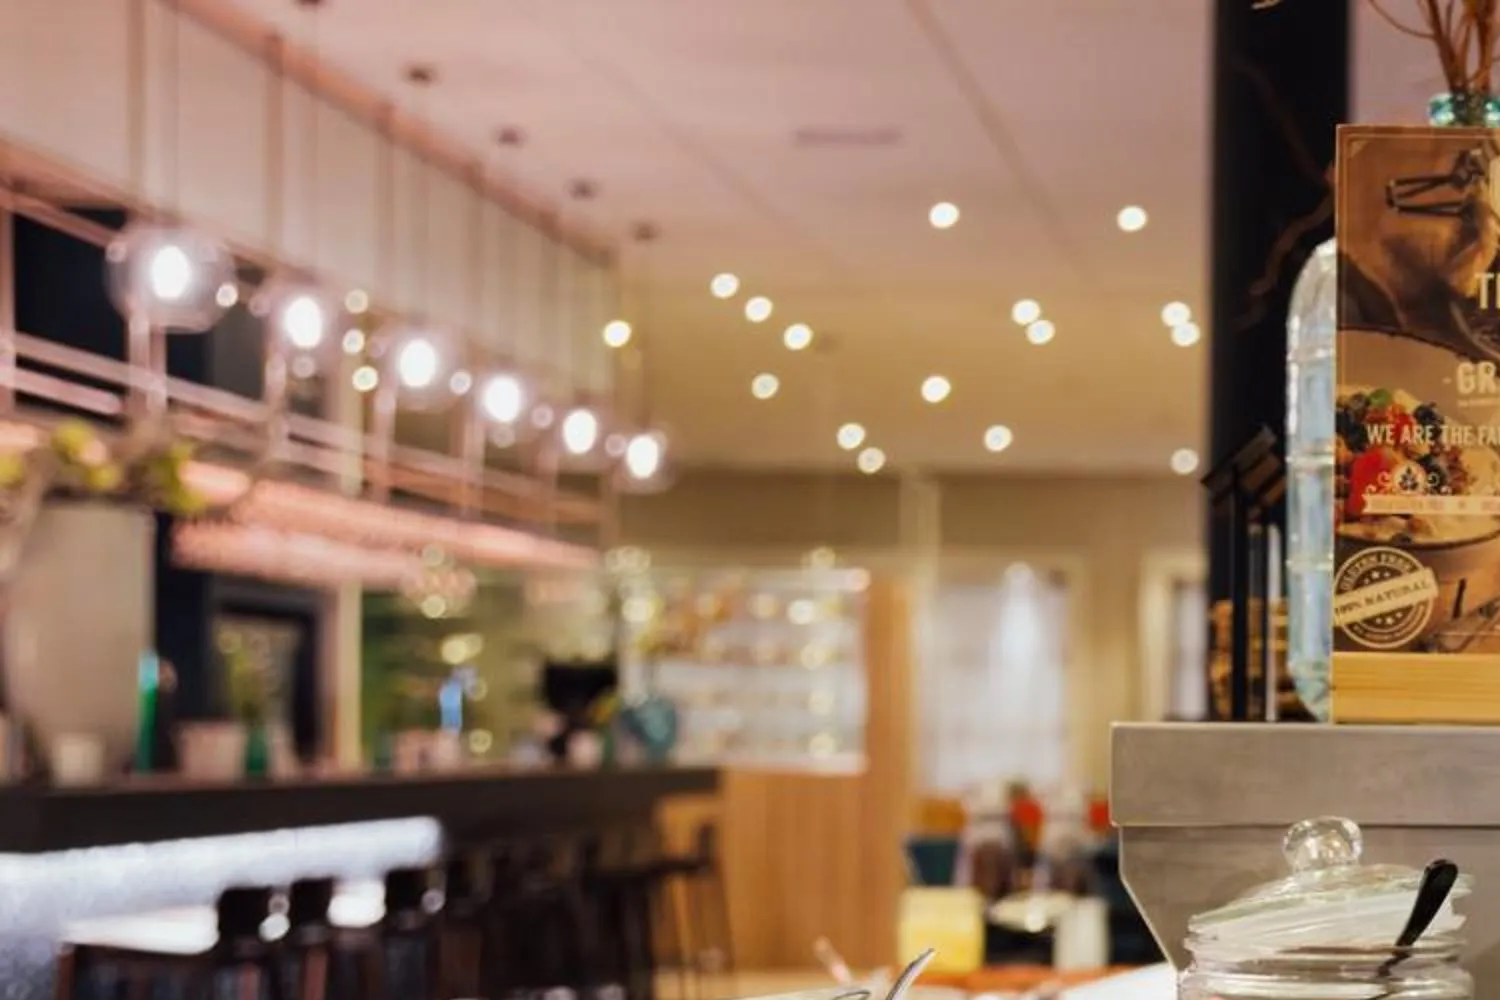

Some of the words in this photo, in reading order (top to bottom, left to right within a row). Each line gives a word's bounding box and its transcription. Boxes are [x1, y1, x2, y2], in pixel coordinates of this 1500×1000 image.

[1367, 424, 1394, 447] WE
[1400, 424, 1435, 447] ARE
[1441, 425, 1473, 447] THE
